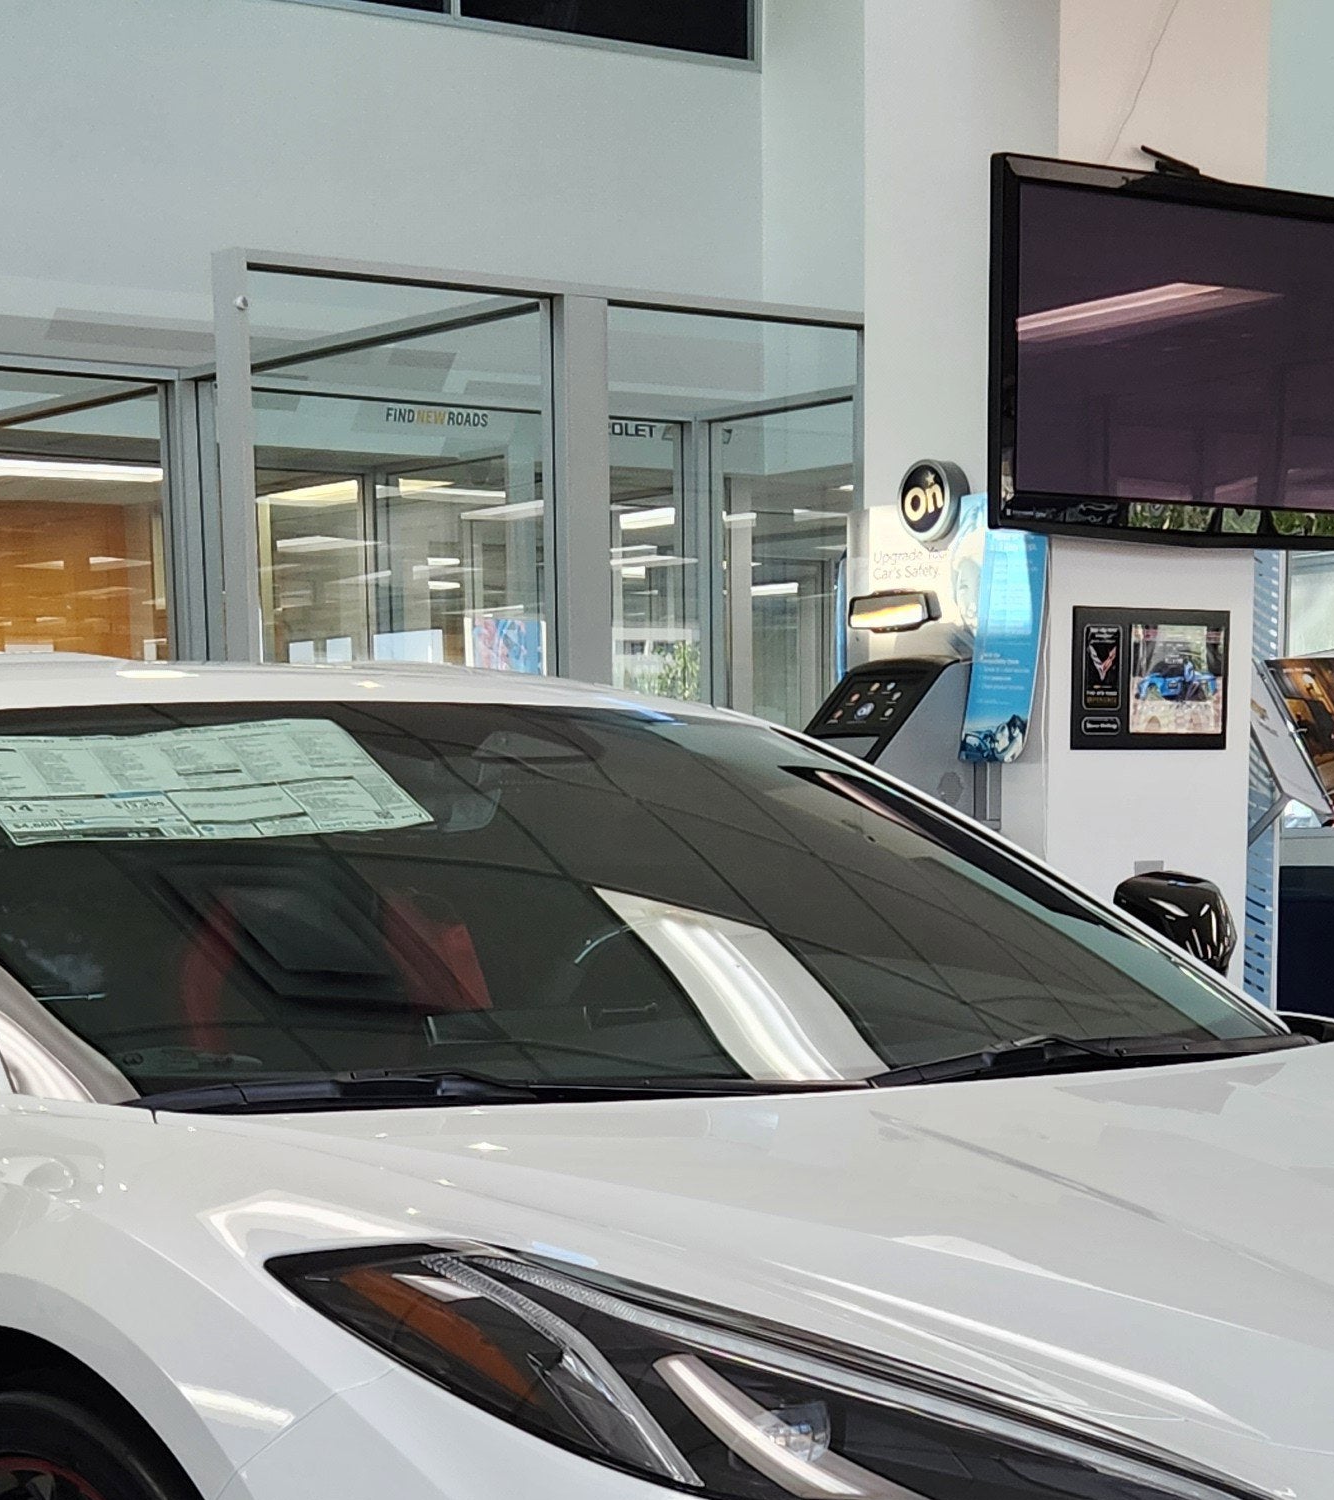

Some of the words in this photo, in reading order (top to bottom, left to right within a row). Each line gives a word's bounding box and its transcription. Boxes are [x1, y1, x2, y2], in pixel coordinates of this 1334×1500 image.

[386, 407, 415, 424] FIND
[416, 410, 446, 425] NEW
[447, 412, 489, 428] ROADS
[609, 421, 657, 438] OLET
[904, 483, 944, 521] On
[873, 548, 923, 566] Upgrade
[873, 567, 902, 581] Car's
